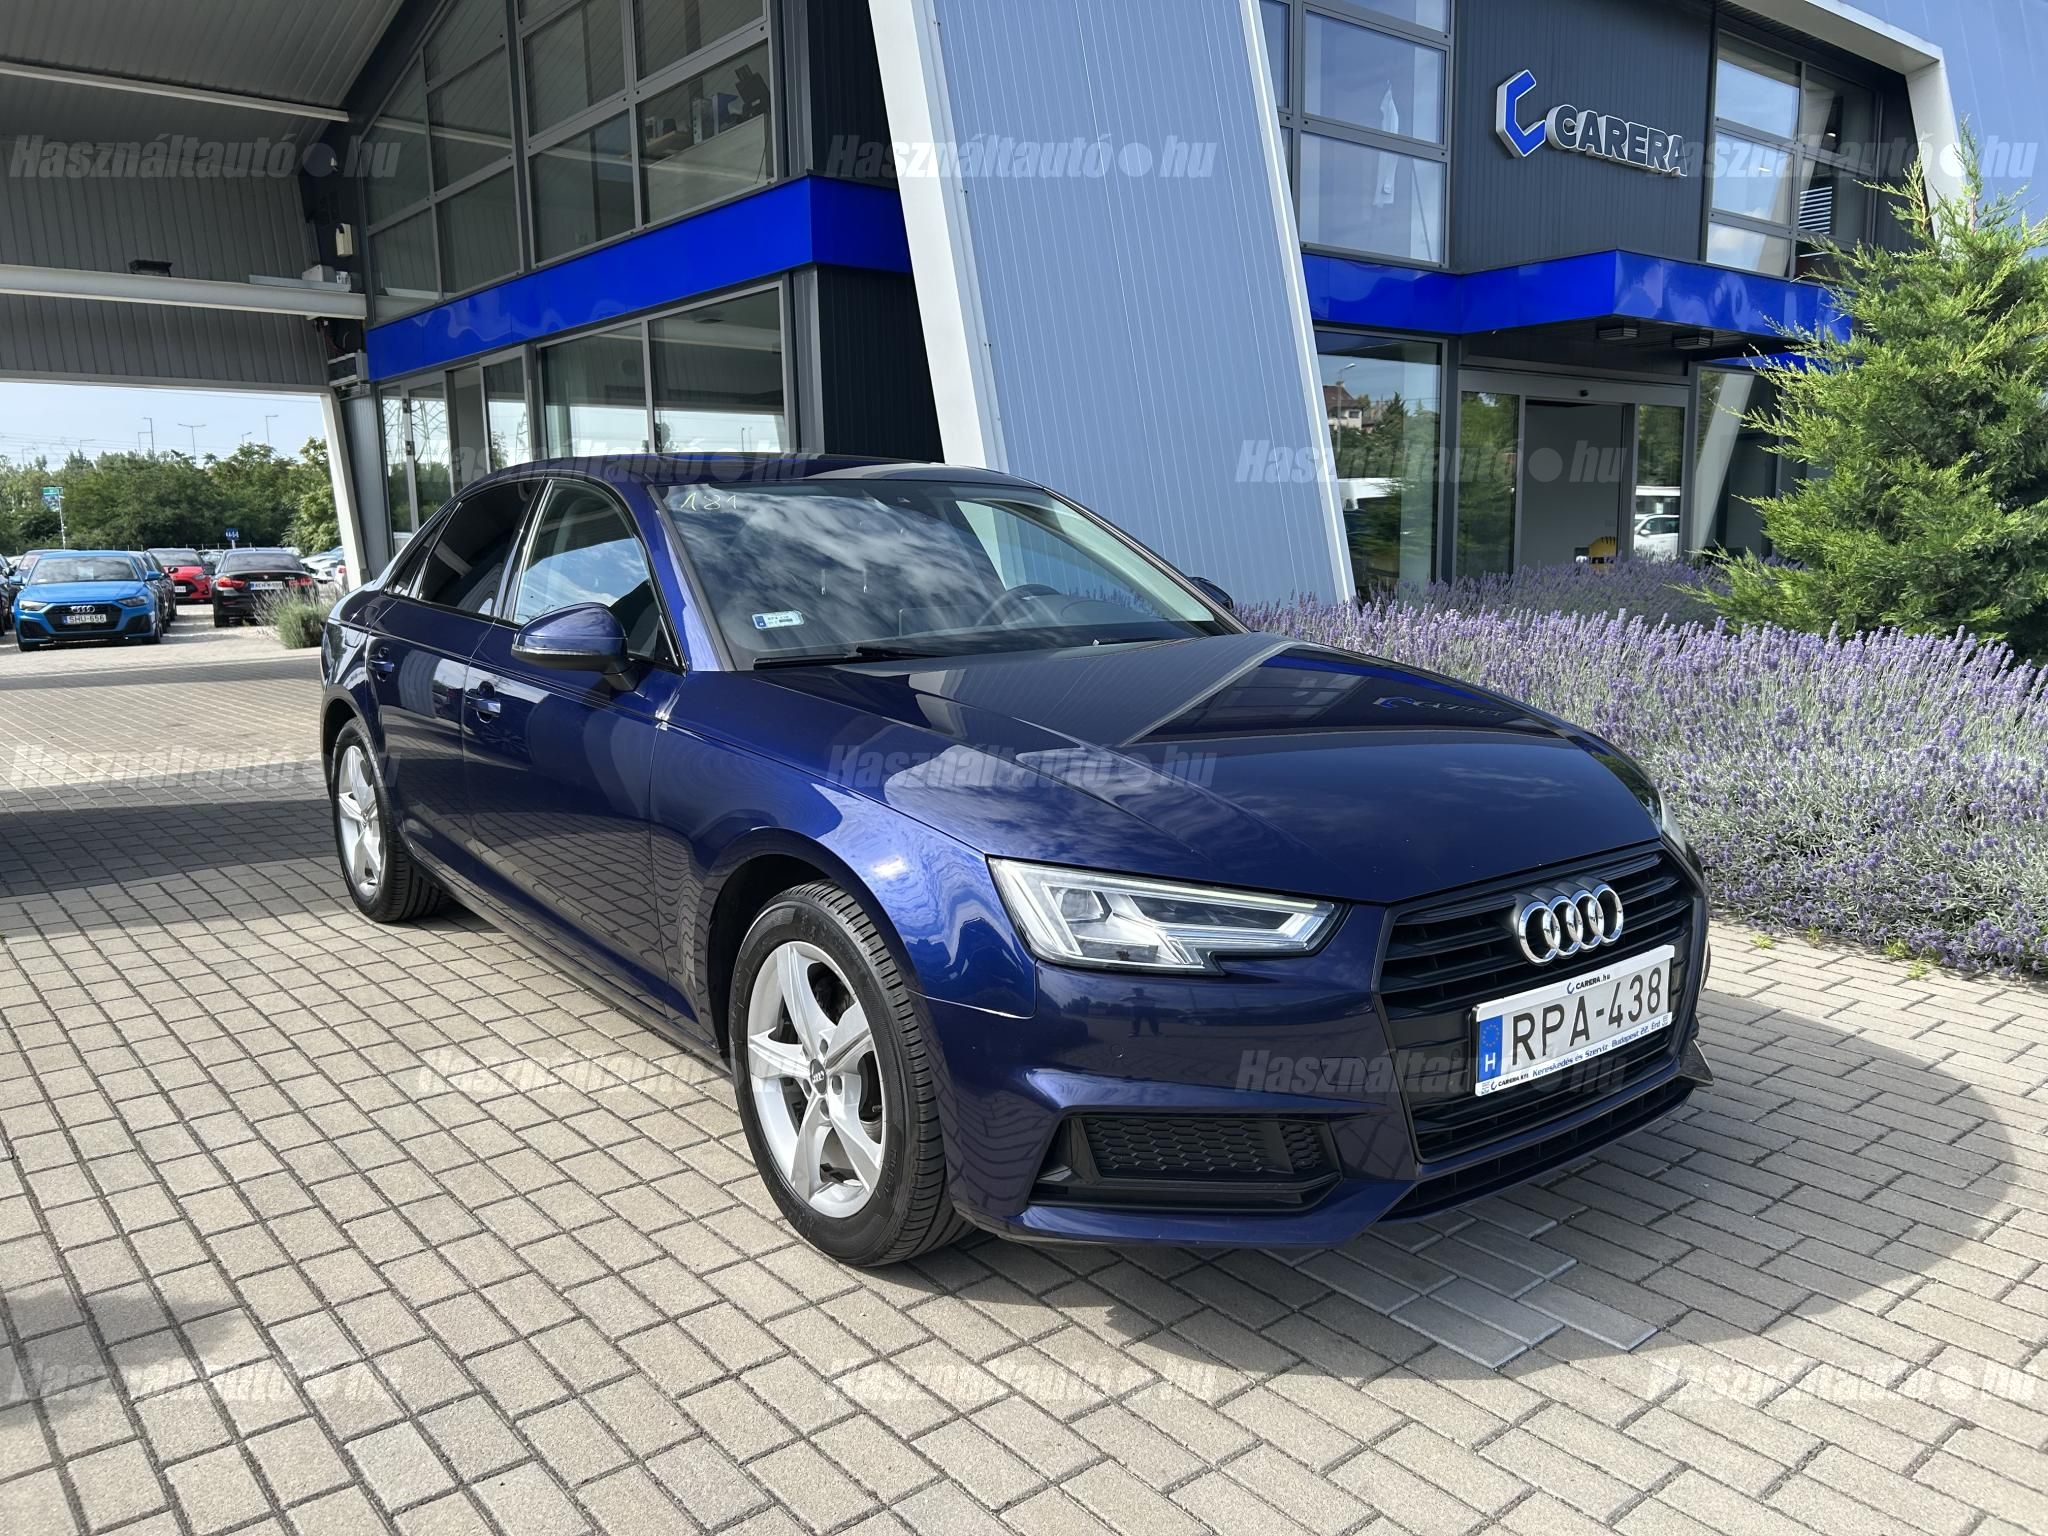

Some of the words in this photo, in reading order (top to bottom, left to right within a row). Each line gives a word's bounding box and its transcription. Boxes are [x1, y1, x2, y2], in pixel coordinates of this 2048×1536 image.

[1546, 104, 1688, 177] CARERA
[1512, 967, 1662, 1065] RPA-438
[1485, 1052, 1496, 1072] H
